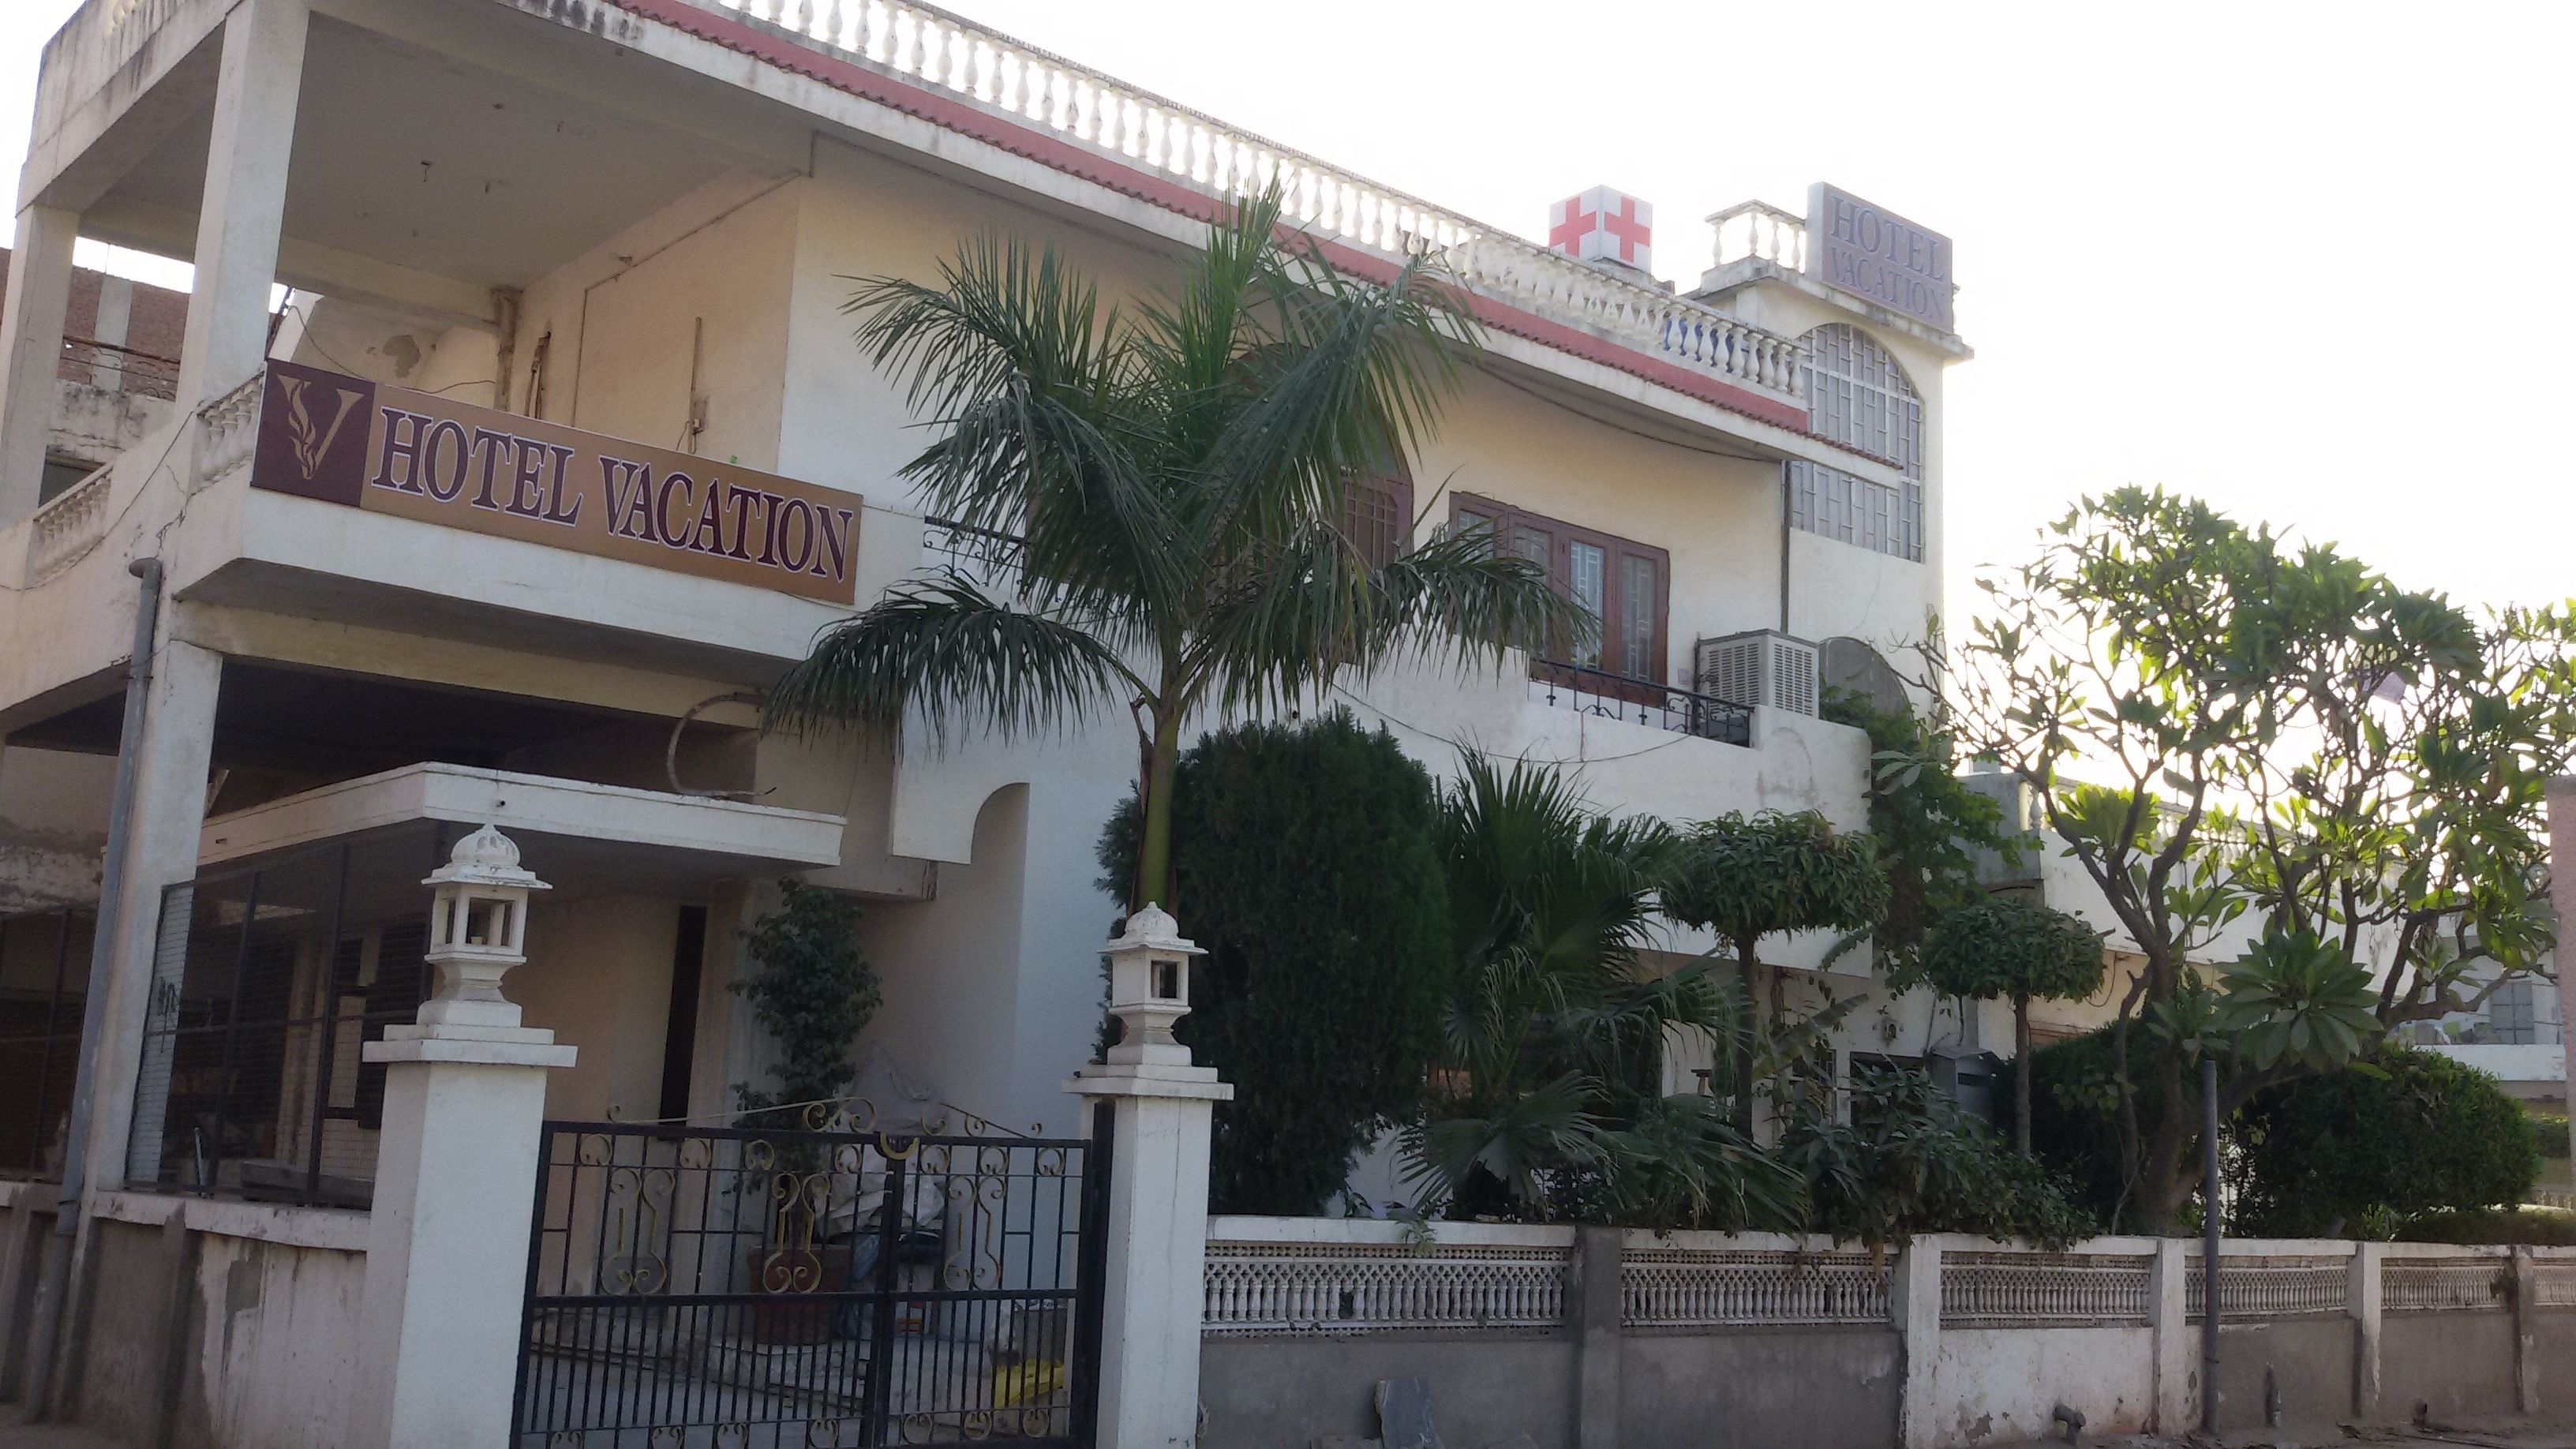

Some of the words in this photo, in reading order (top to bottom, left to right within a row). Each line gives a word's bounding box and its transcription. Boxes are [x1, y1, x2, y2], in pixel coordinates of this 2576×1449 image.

[1830, 195, 1945, 281] HOTEL
[1831, 245, 1945, 323] VACATION
[371, 406, 584, 527] HOTEL
[598, 454, 854, 582] VACATION
